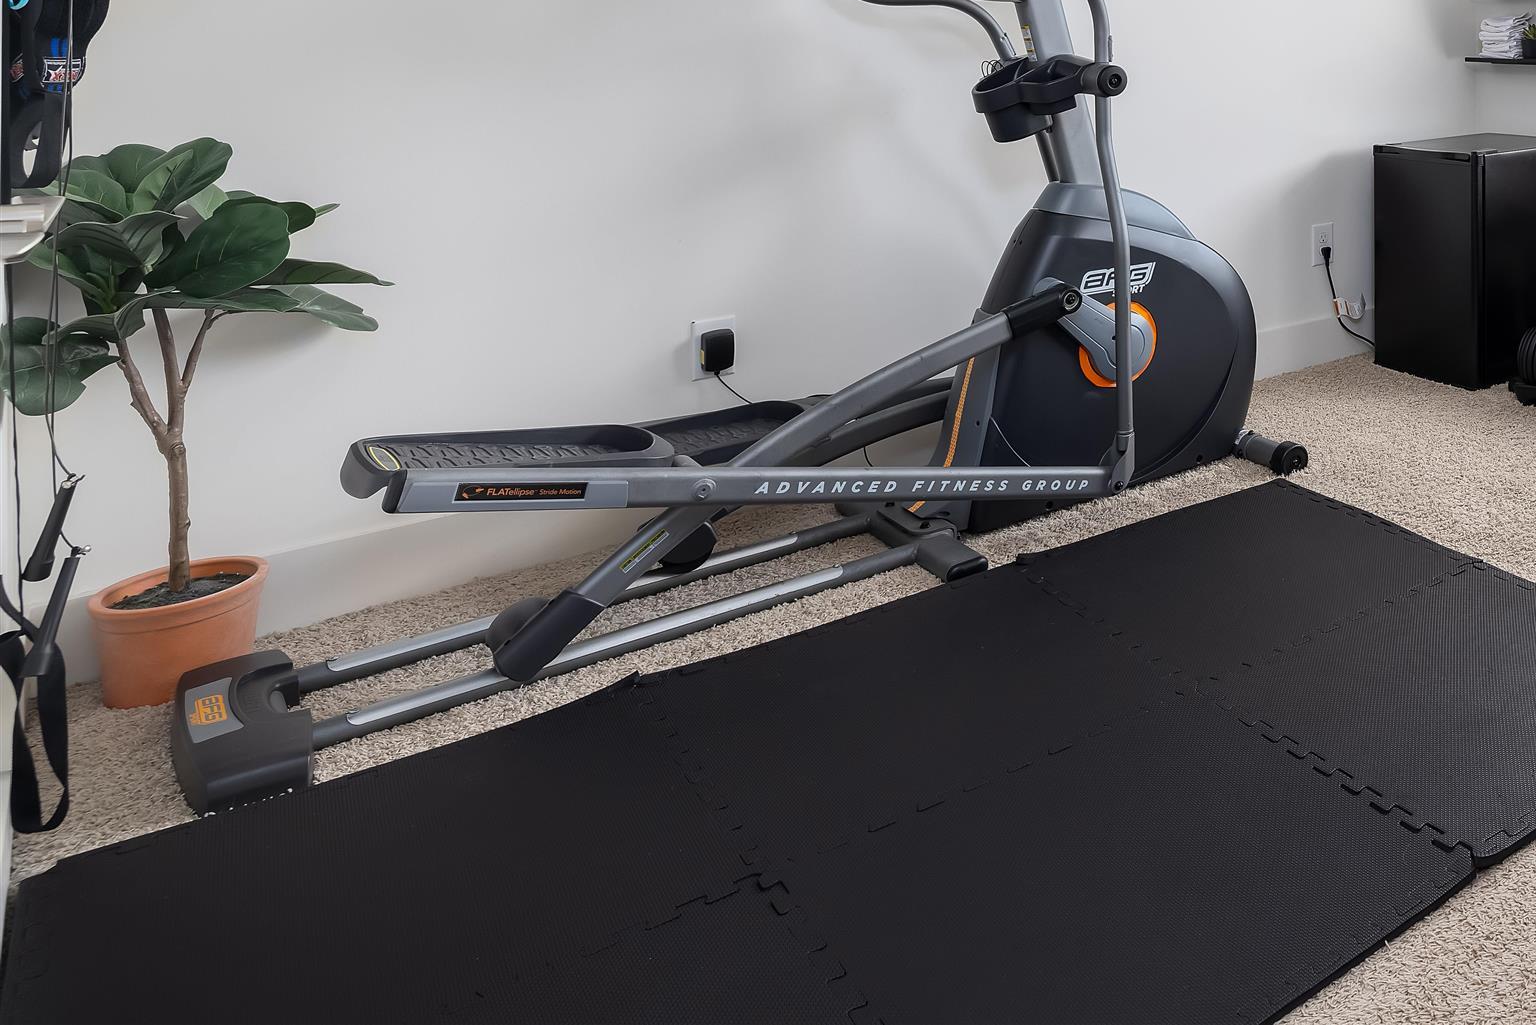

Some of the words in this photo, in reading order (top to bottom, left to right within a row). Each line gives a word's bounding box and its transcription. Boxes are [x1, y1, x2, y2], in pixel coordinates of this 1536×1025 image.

[1112, 284, 1146, 297] ORT
[486, 487, 535, 497] FLATellipse
[538, 488, 558, 496] Stride
[558, 488, 582, 496] Motion
[754, 480, 899, 494] ADVANCED
[911, 479, 1010, 492] FITNESS
[1021, 478, 1090, 491] GROUP
